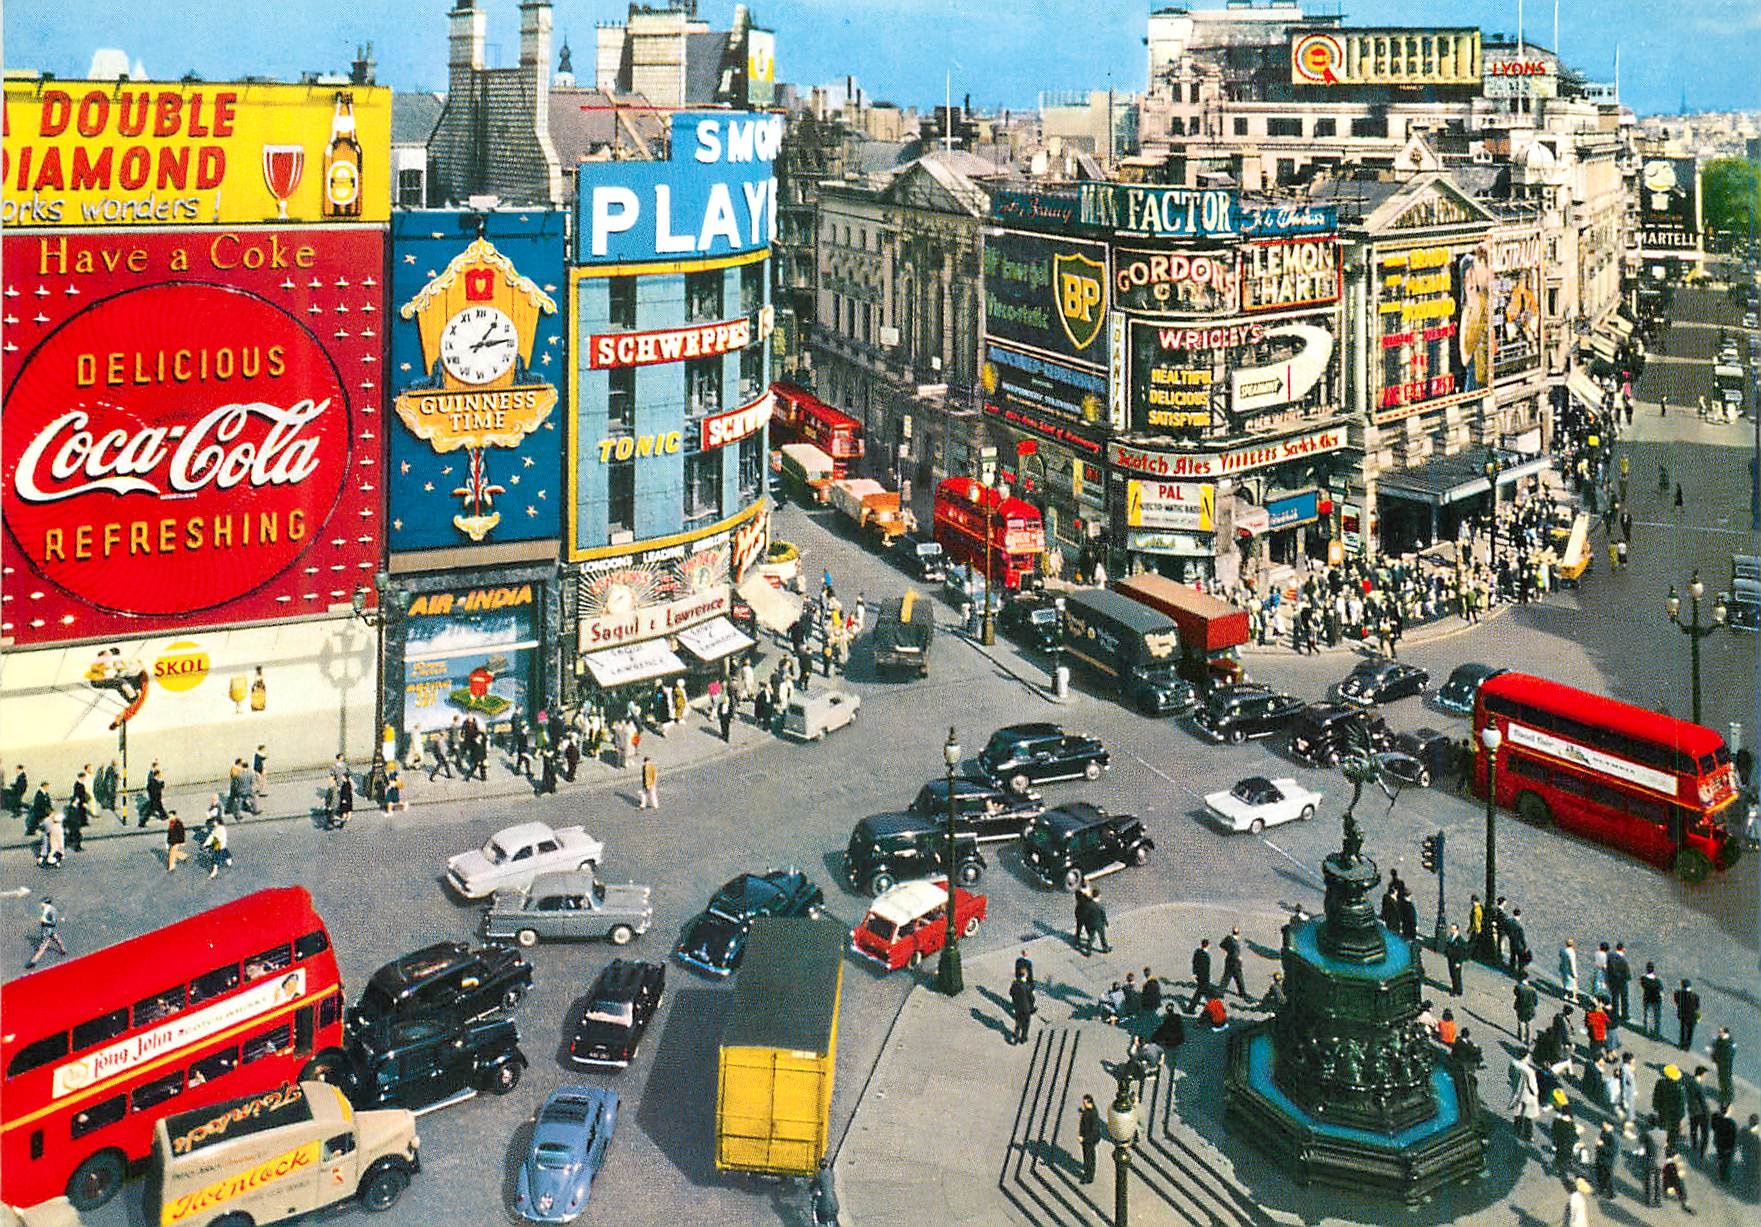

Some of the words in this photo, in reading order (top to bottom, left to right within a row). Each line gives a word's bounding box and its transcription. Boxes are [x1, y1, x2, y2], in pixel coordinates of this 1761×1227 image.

[1493, 62, 1545, 76] LYONS
[40, 90, 237, 137] DOUBLE
[3, 146, 226, 191] IAMOND
[1128, 189, 1231, 232] FACTOR
[38, 236, 148, 275] Have
[169, 247, 189, 271] a
[210, 234, 316, 269] Coke
[1636, 232, 1697, 246] MARTELL
[1253, 242, 1334, 276] LEMON
[1062, 273, 1101, 322] BP
[598, 320, 750, 364] SCHWEPPES
[77, 345, 286, 387] DELICIOUS
[420, 392, 537, 415] GUINNESS
[1149, 389, 1209, 406] DELICIOUS
[449, 412, 506, 432] TIME
[15, 397, 332, 502] Coca-Cola
[599, 431, 682, 463] TONIC
[1116, 447, 1168, 475] Scotch
[1174, 456, 1212, 476] Ales
[1159, 484, 1185, 501] PAL
[45, 510, 306, 562] REFRESHING
[666, 598, 725, 627] Lawrence
[155, 658, 206, 677] SKOL
[133, 1027, 174, 1061] John
